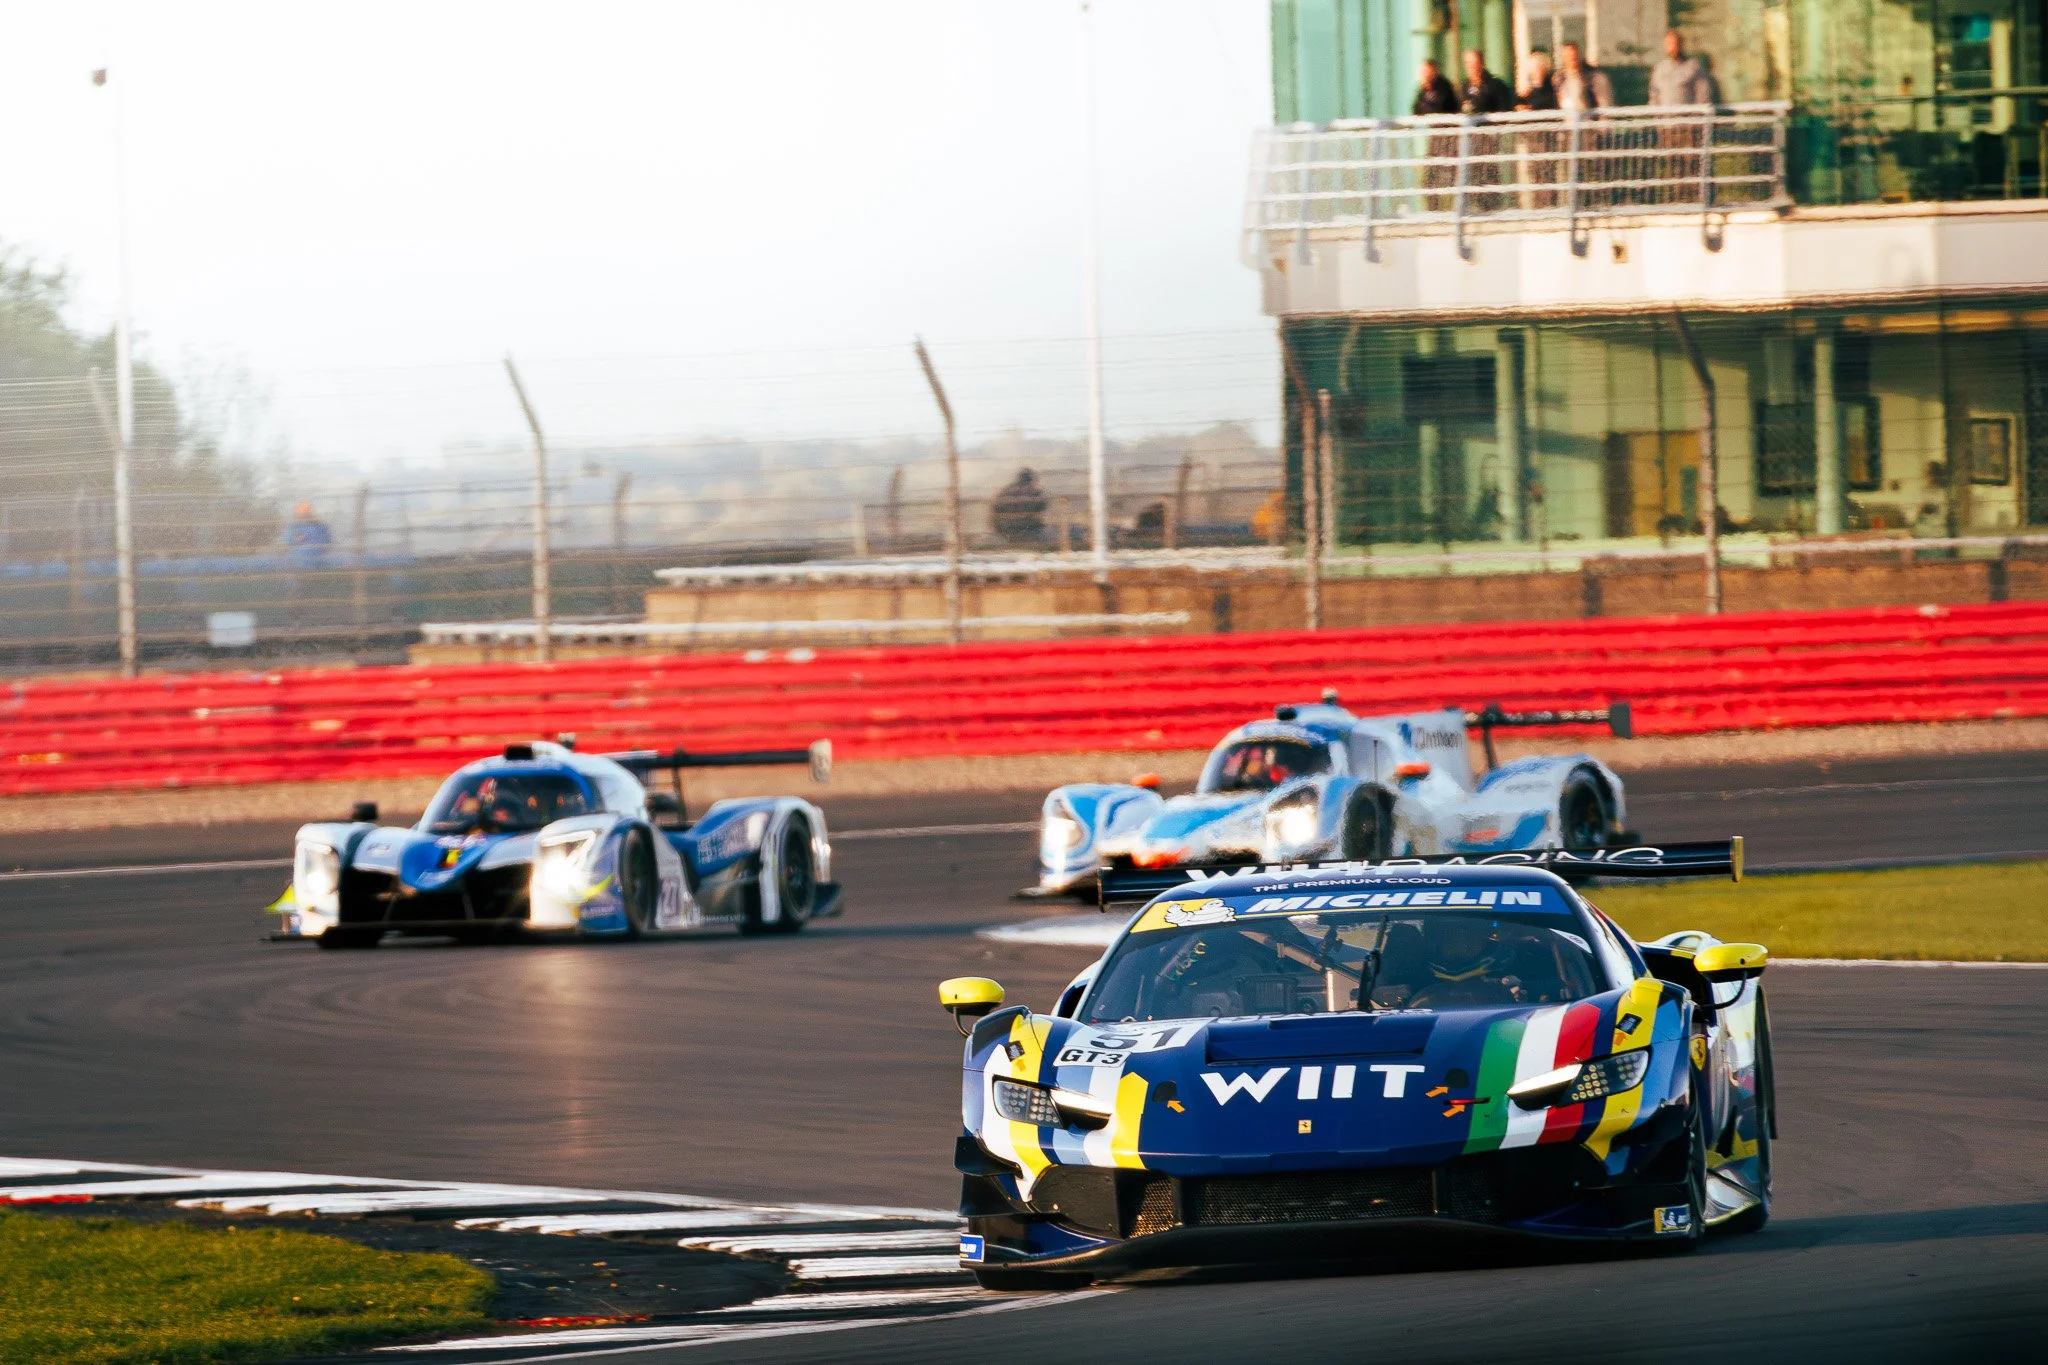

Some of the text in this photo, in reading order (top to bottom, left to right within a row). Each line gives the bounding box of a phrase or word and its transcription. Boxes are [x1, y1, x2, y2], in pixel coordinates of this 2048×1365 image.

[1253, 876, 1451, 893] THE PREMIUM CLOUD
[1246, 892, 1541, 913] MICHELIN
[1090, 1027, 1184, 1050] 51
[1060, 1049, 1123, 1064] GT3
[1200, 1065, 1425, 1106] WIIT
